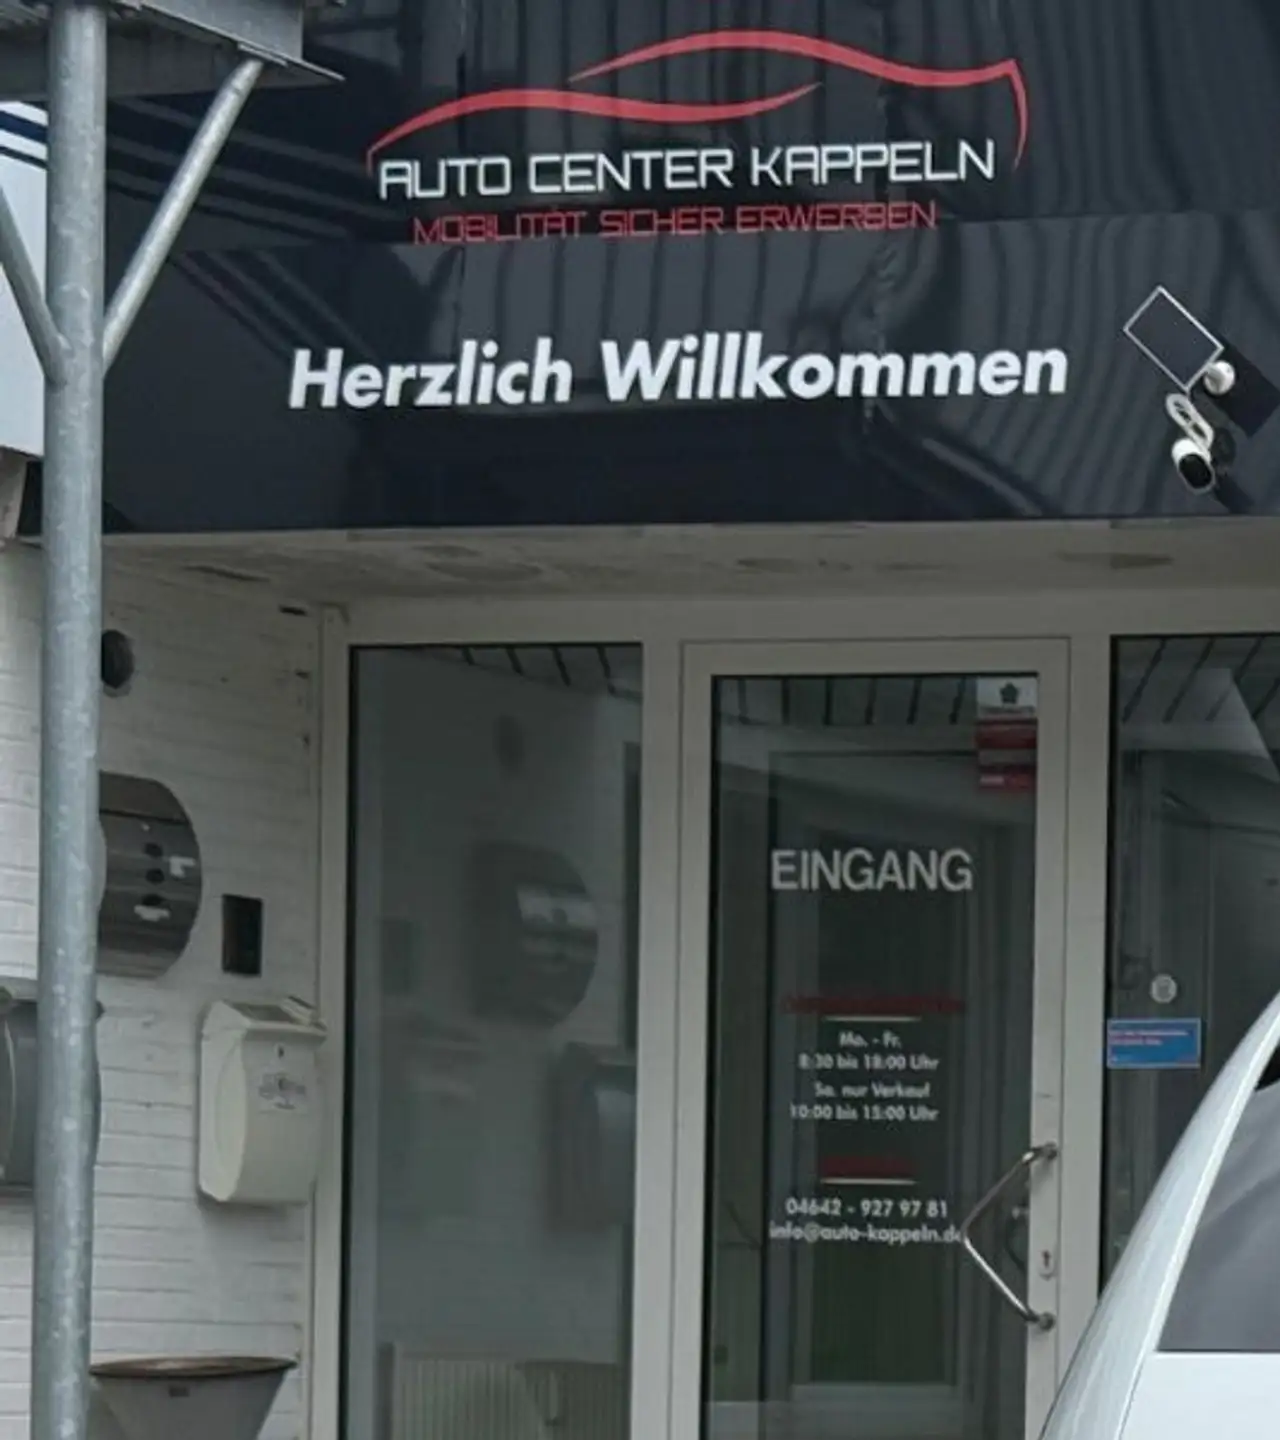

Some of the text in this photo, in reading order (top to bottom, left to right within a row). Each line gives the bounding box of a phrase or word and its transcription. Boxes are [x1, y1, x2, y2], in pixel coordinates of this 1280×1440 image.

[380, 139, 995, 200] AUTO CENTER KAPPELN
[598, 205, 726, 239] SICHER
[736, 201, 940, 234] ERWERBEN
[288, 331, 1069, 409] Herzlich Willkommen
[771, 847, 974, 892] EINGANG
[838, 1030, 869, 1048] Mo.
[883, 1030, 901, 1048] Fr.
[837, 1053, 858, 1070] bis
[909, 1053, 940, 1071] Uhr
[841, 1085, 869, 1099] nur
[871, 1081, 931, 1099] Verkauf
[836, 1104, 858, 1121] bis
[909, 1104, 940, 1122] Uhr
[785, 1197, 842, 1217] 04642
[860, 1199, 894, 1218] 927
[899, 1199, 922, 1218] 97
[926, 1200, 948, 1219] 81
